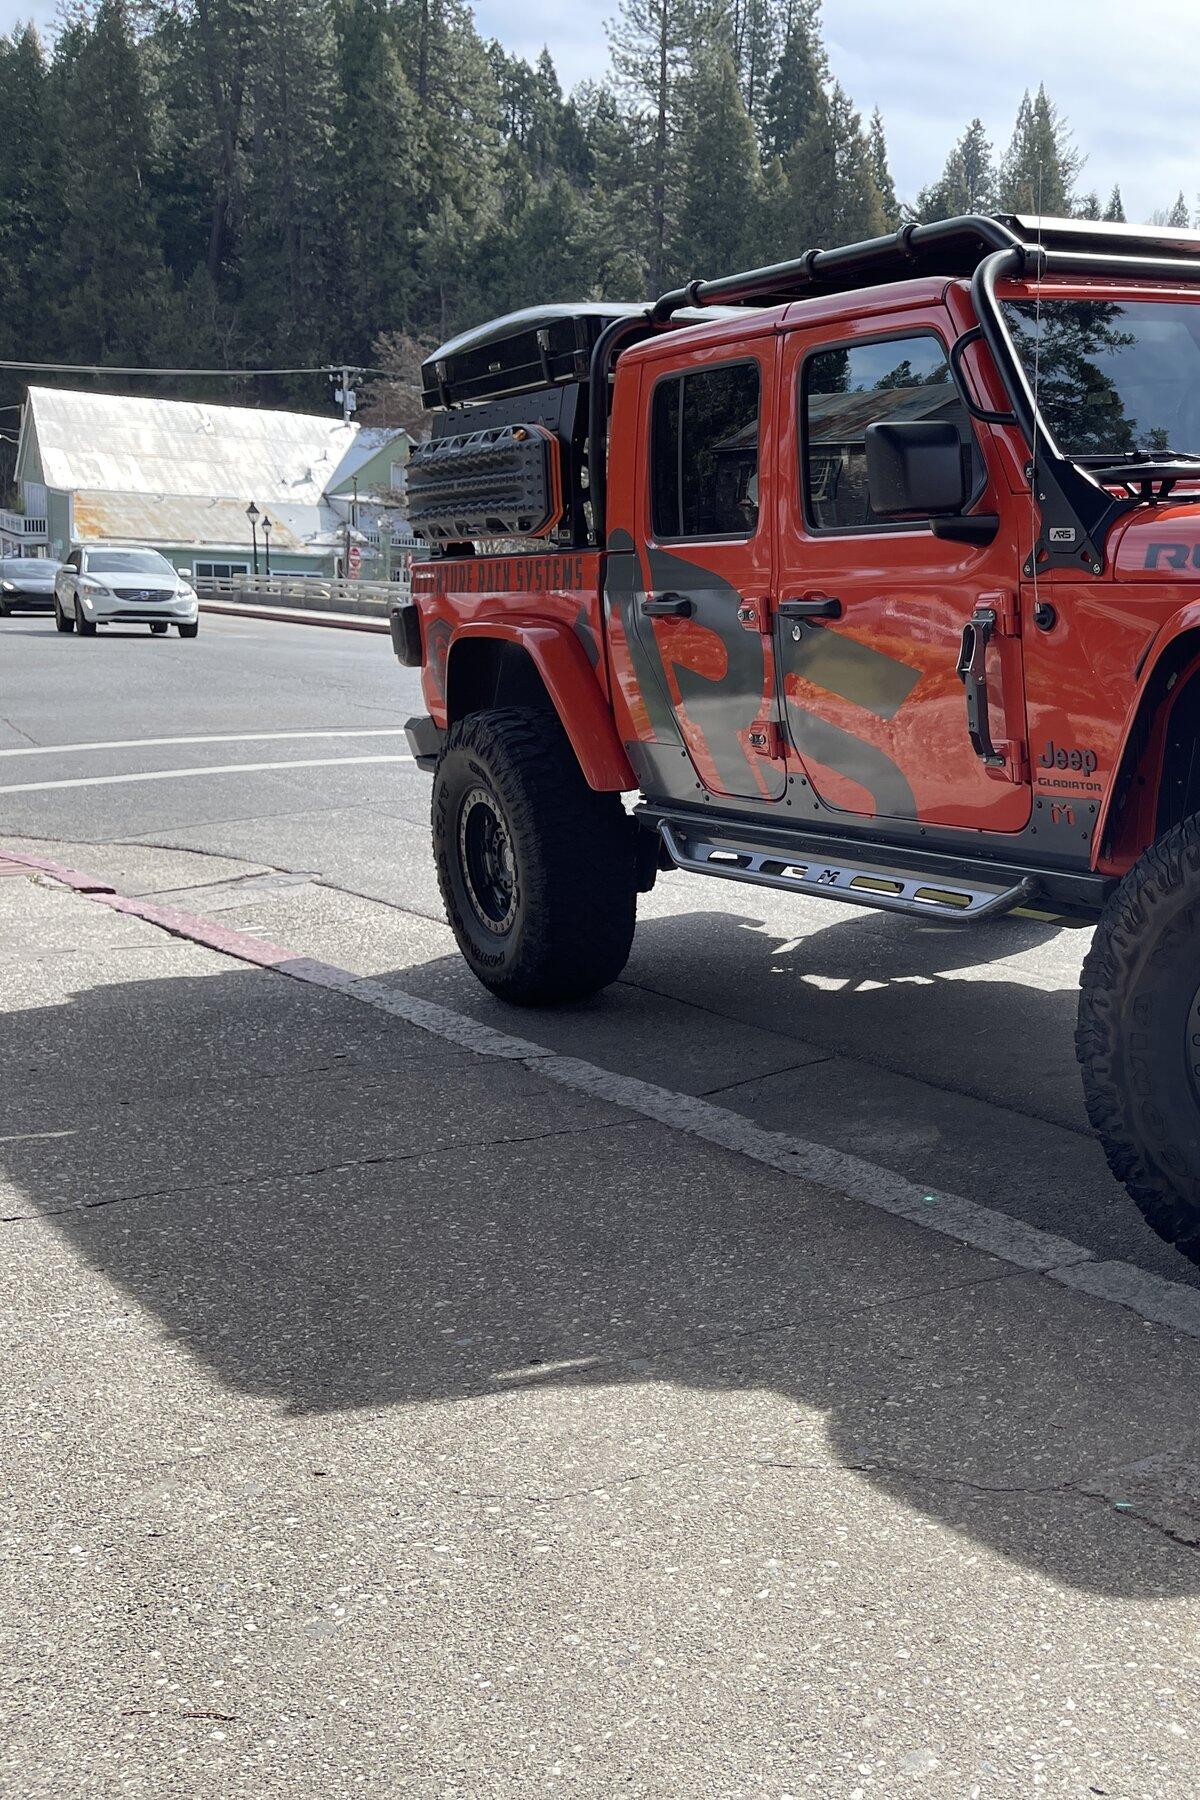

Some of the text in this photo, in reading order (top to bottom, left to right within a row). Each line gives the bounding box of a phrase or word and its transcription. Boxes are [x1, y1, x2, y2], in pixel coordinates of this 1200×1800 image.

[1053, 530, 1071, 539] ARS
[516, 557, 583, 593] SYSTEMS
[1039, 740, 1098, 778] Jeep
[1037, 777, 1103, 792] GLADIATOR
